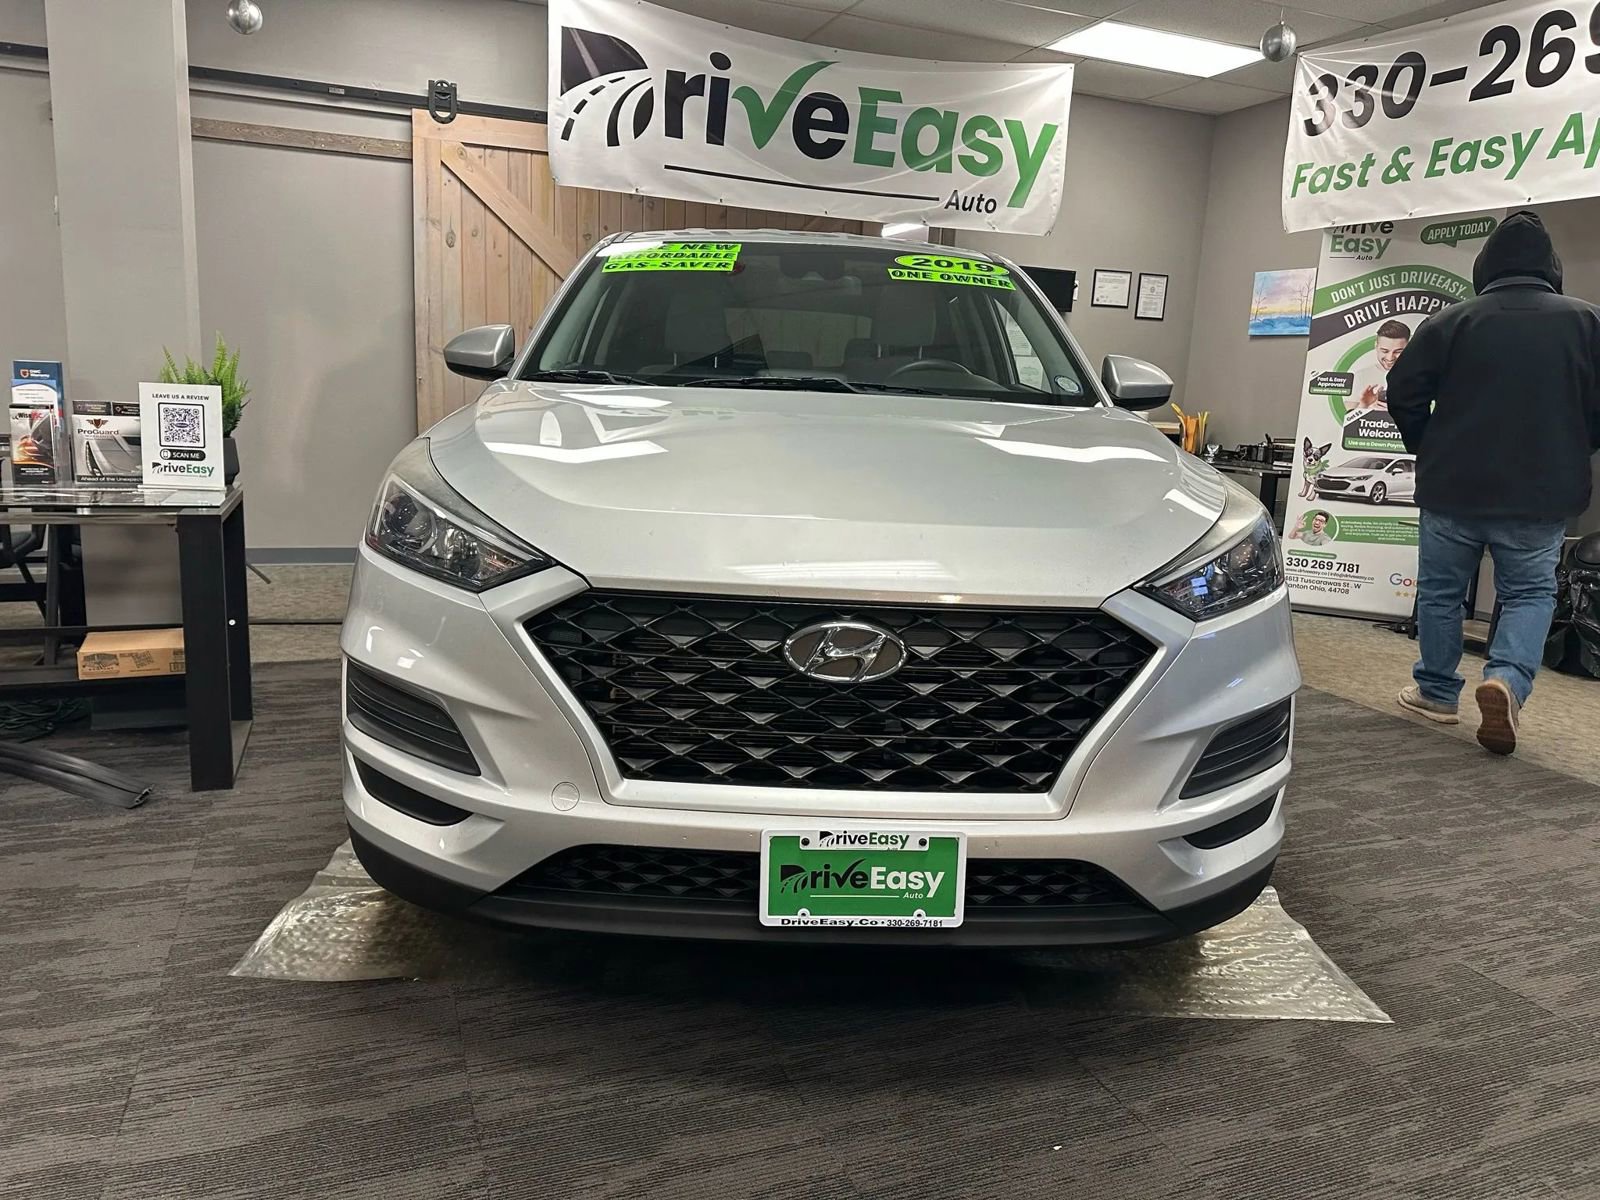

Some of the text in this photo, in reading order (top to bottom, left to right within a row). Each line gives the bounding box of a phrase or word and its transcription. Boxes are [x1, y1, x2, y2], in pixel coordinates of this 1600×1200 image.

[1290, 153, 1376, 198] Fast
[1381, 146, 1414, 185] &
[1424, 128, 1543, 180] Easy
[945, 190, 997, 214] Auto
[1427, 221, 1492, 241] APPLY TODAY
[681, 243, 735, 251] NEW
[1330, 234, 1392, 260] Easy
[912, 257, 994, 273] 2019
[891, 270, 1011, 288] ONE OWNER
[1331, 283, 1365, 303] DON'T
[1369, 273, 1396, 290] JUST
[1344, 297, 1391, 328] DRIVE
[1359, 428, 1402, 439] Welcom
[1286, 557, 1360, 574] 330 269 7181
[1328, 587, 1350, 595] 44708
[819, 831, 910, 849] DriveEasy
[780, 858, 945, 898] DriveEasy
[903, 891, 924, 899] Auto
[781, 918, 943, 928] DriveEasy.Co 330-269-7181
